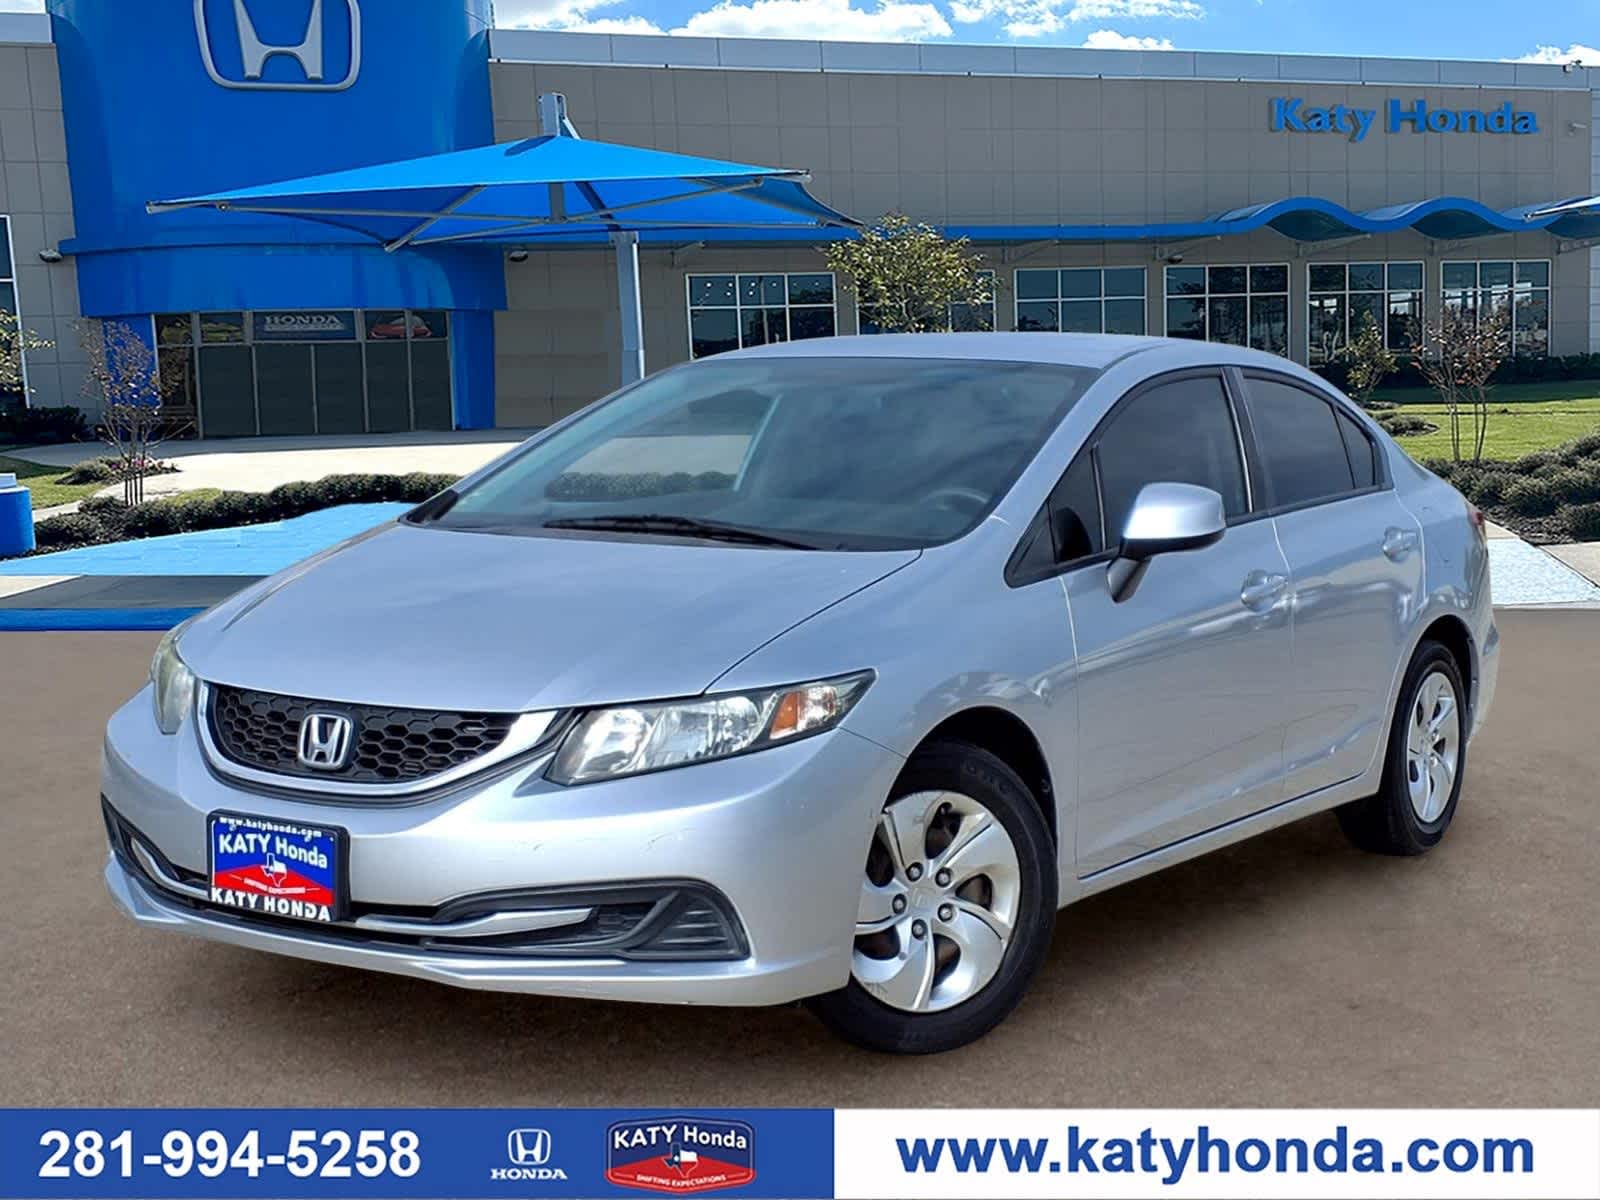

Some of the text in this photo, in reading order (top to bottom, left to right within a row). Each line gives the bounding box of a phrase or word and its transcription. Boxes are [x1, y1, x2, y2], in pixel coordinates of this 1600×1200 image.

[1268, 97, 1540, 142] Katy Honda
[264, 315, 341, 325] HONDA
[219, 817, 322, 838] www.katyhonda.com
[219, 834, 328, 869] KATY Honda
[211, 888, 331, 922] KATY HONDA
